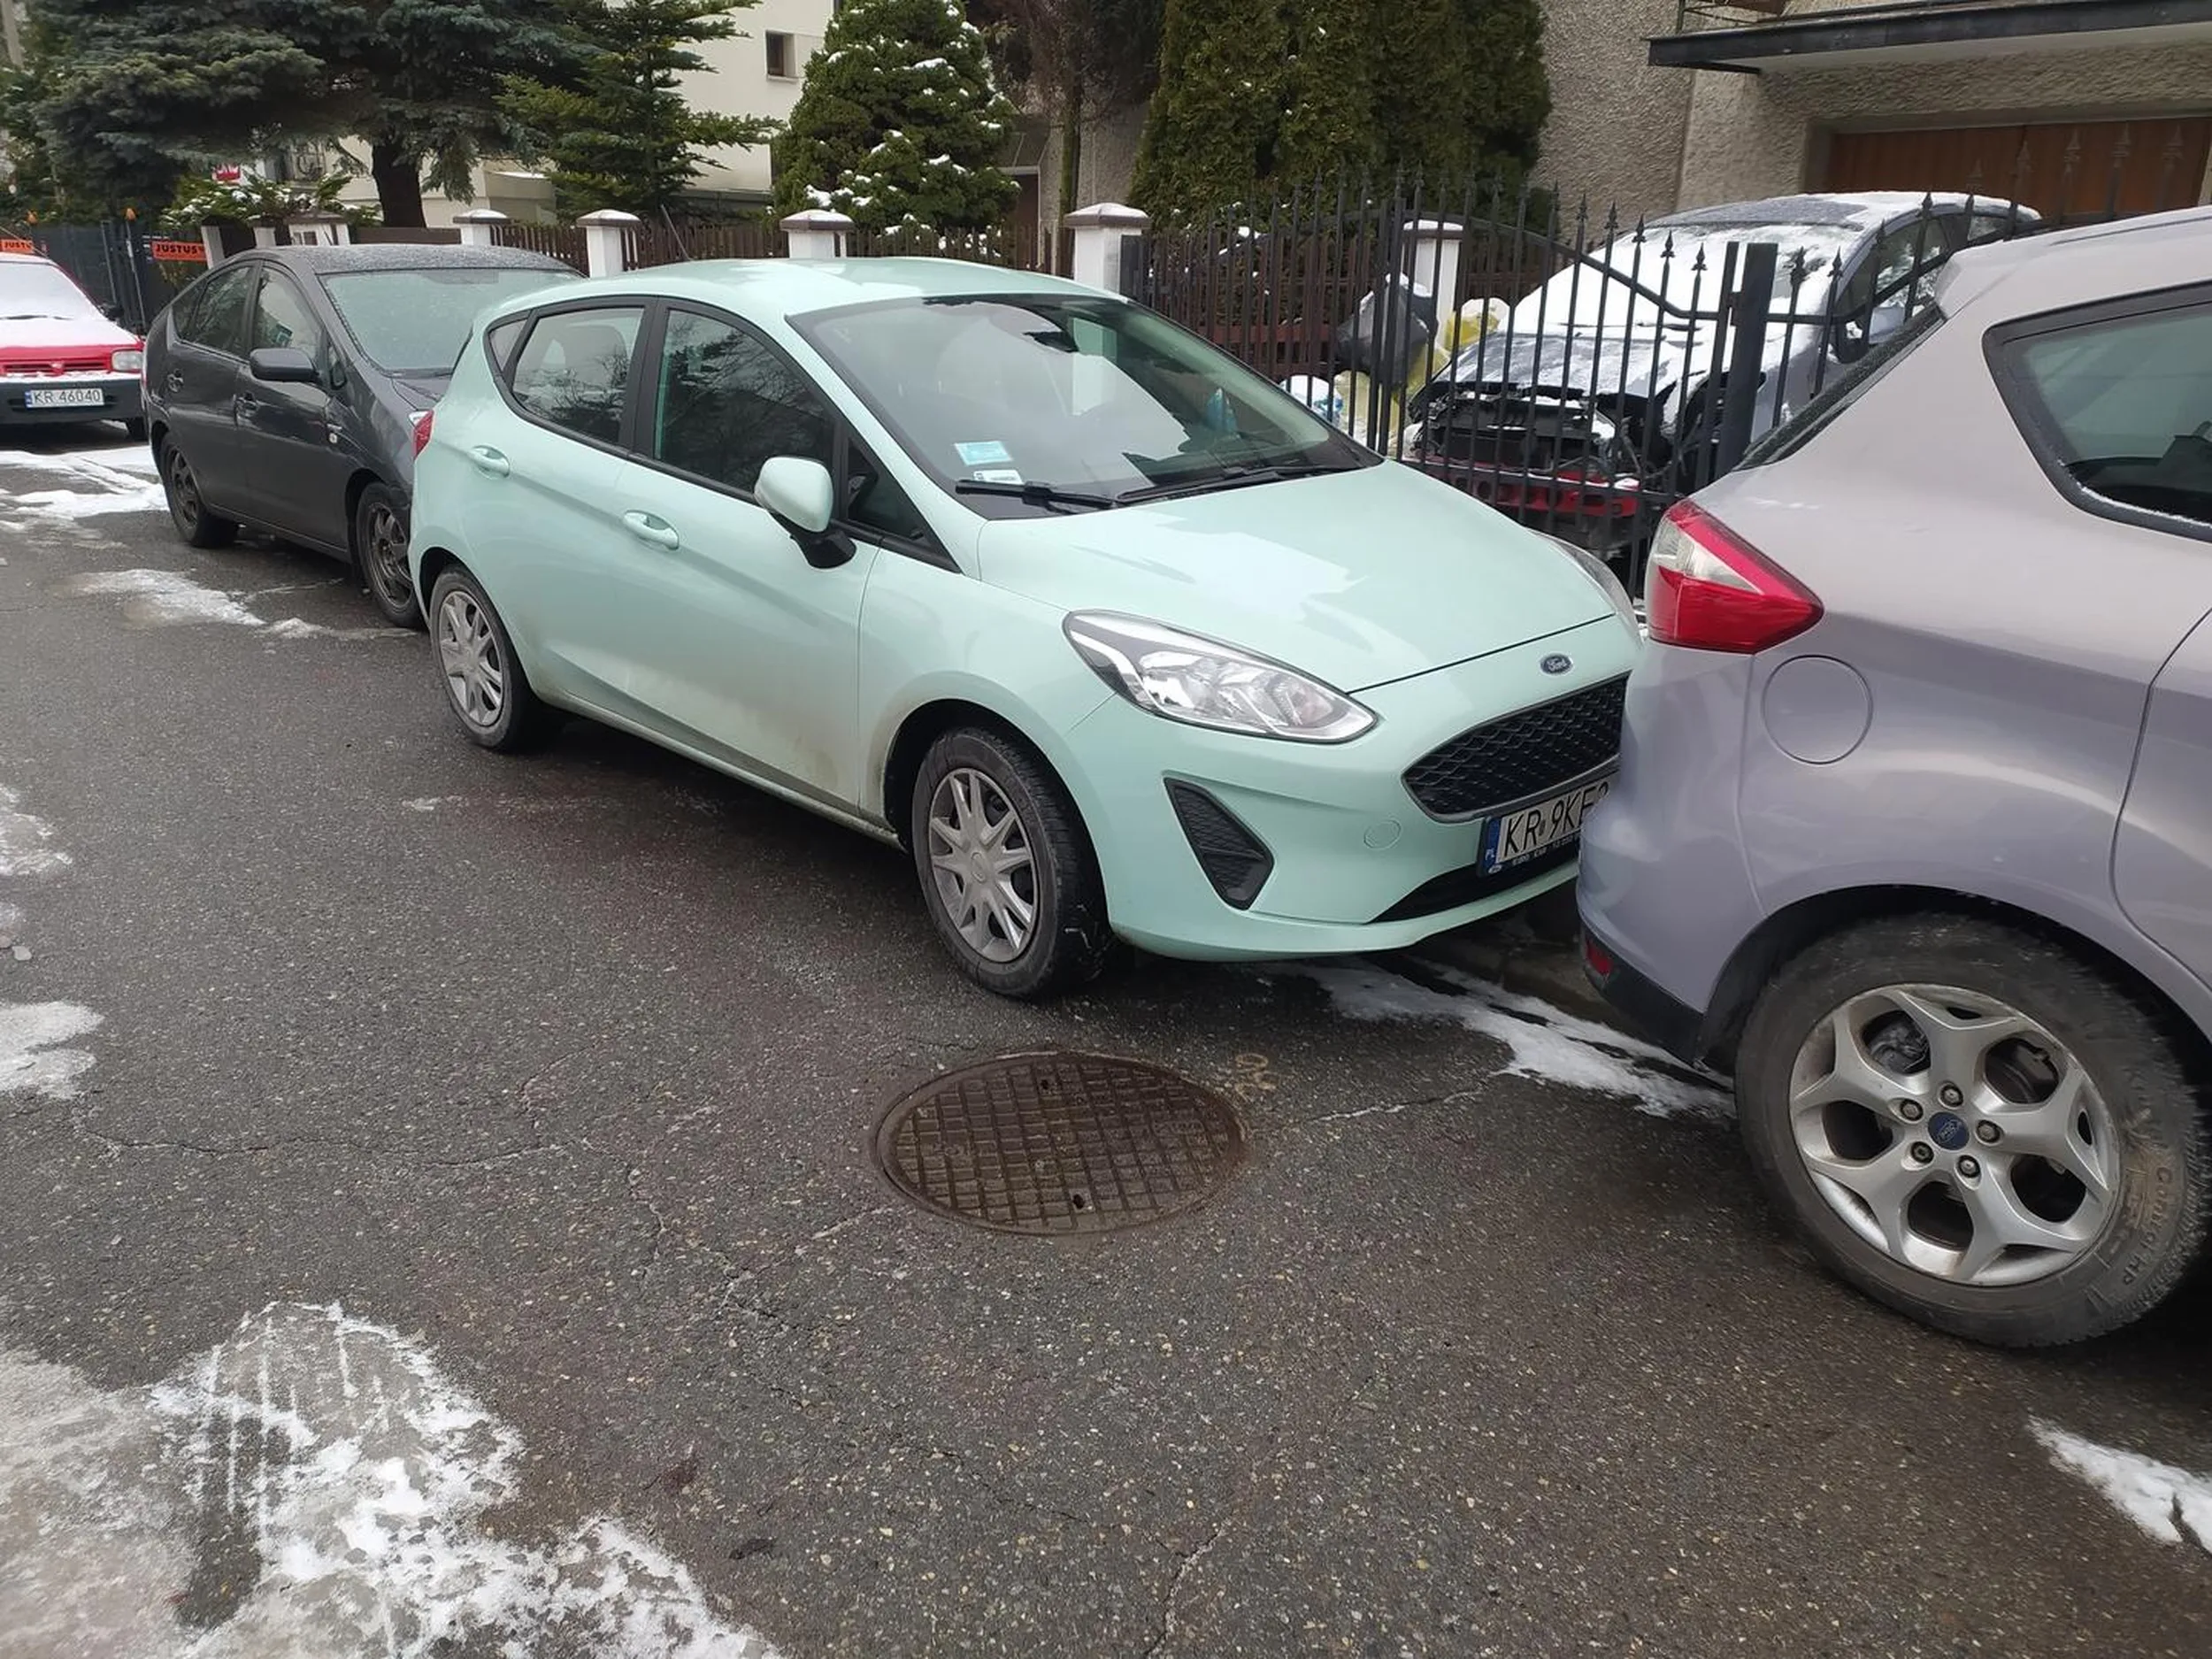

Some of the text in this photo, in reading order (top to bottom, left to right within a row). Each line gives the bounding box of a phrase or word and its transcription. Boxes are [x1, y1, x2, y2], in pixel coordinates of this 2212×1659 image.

[156, 244, 198, 254] JUSTUS
[35, 389, 102, 405] KR 46040
[1504, 809, 1542, 857] KR
